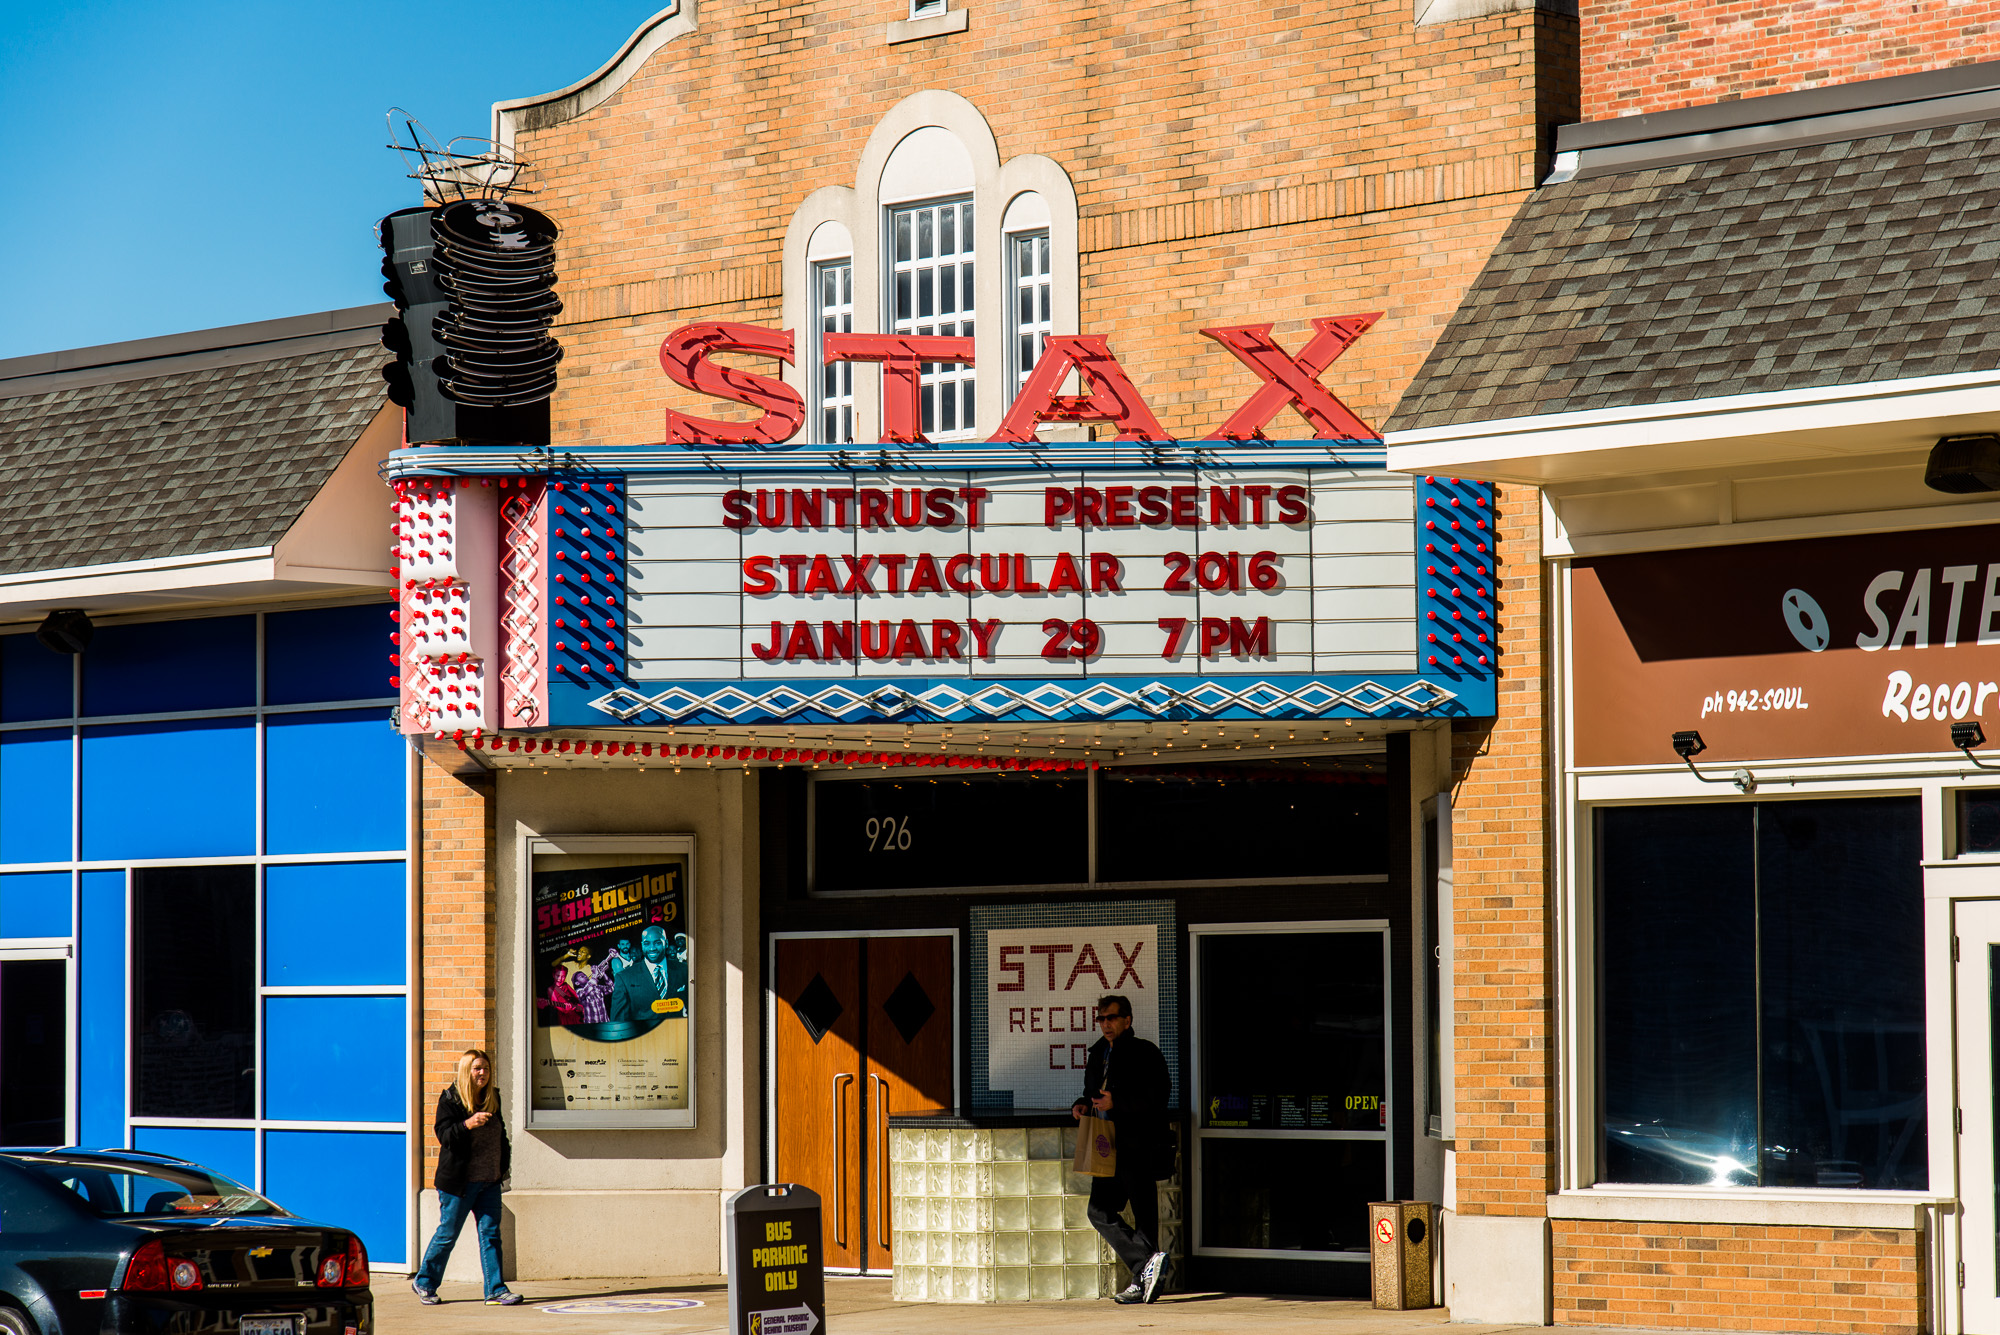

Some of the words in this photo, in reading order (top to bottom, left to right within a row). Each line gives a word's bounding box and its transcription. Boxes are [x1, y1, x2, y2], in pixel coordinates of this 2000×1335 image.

[660, 311, 1384, 446] STAX
[722, 487, 987, 529] SUNTRUST
[1044, 485, 1308, 527] PRESENTS
[743, 552, 1121, 595] STAXTACULAR
[1163, 551, 1278, 591] 2016
[751, 618, 1000, 661] JANUARY
[1041, 618, 1100, 658] 29
[1158, 617, 1187, 658] 7
[1201, 616, 1269, 657] PM
[1701, 691, 1723, 719] ph
[1882, 670, 2000, 723] Recor
[866, 815, 912, 852] 926
[537, 871, 677, 931] Staxtacular
[560, 884, 589, 902] 2016
[651, 901, 677, 923] 29
[568, 930, 604, 945] SOULSVILLE
[605, 919, 643, 934] FOUNDATION
[997, 942, 1145, 991] STAX
[1050, 1044, 1087, 1069] CO
[1345, 1095, 1379, 1110] OPEN
[765, 1221, 792, 1242] BUS
[752, 1244, 808, 1268] PARKING
[764, 1270, 798, 1292] ONLY
[764, 1316, 786, 1325] GENERAL
[787, 1313, 809, 1323] PARKING
[764, 1325, 782, 1335] BEHIND
[784, 1323, 807, 1333] MUSEUM
